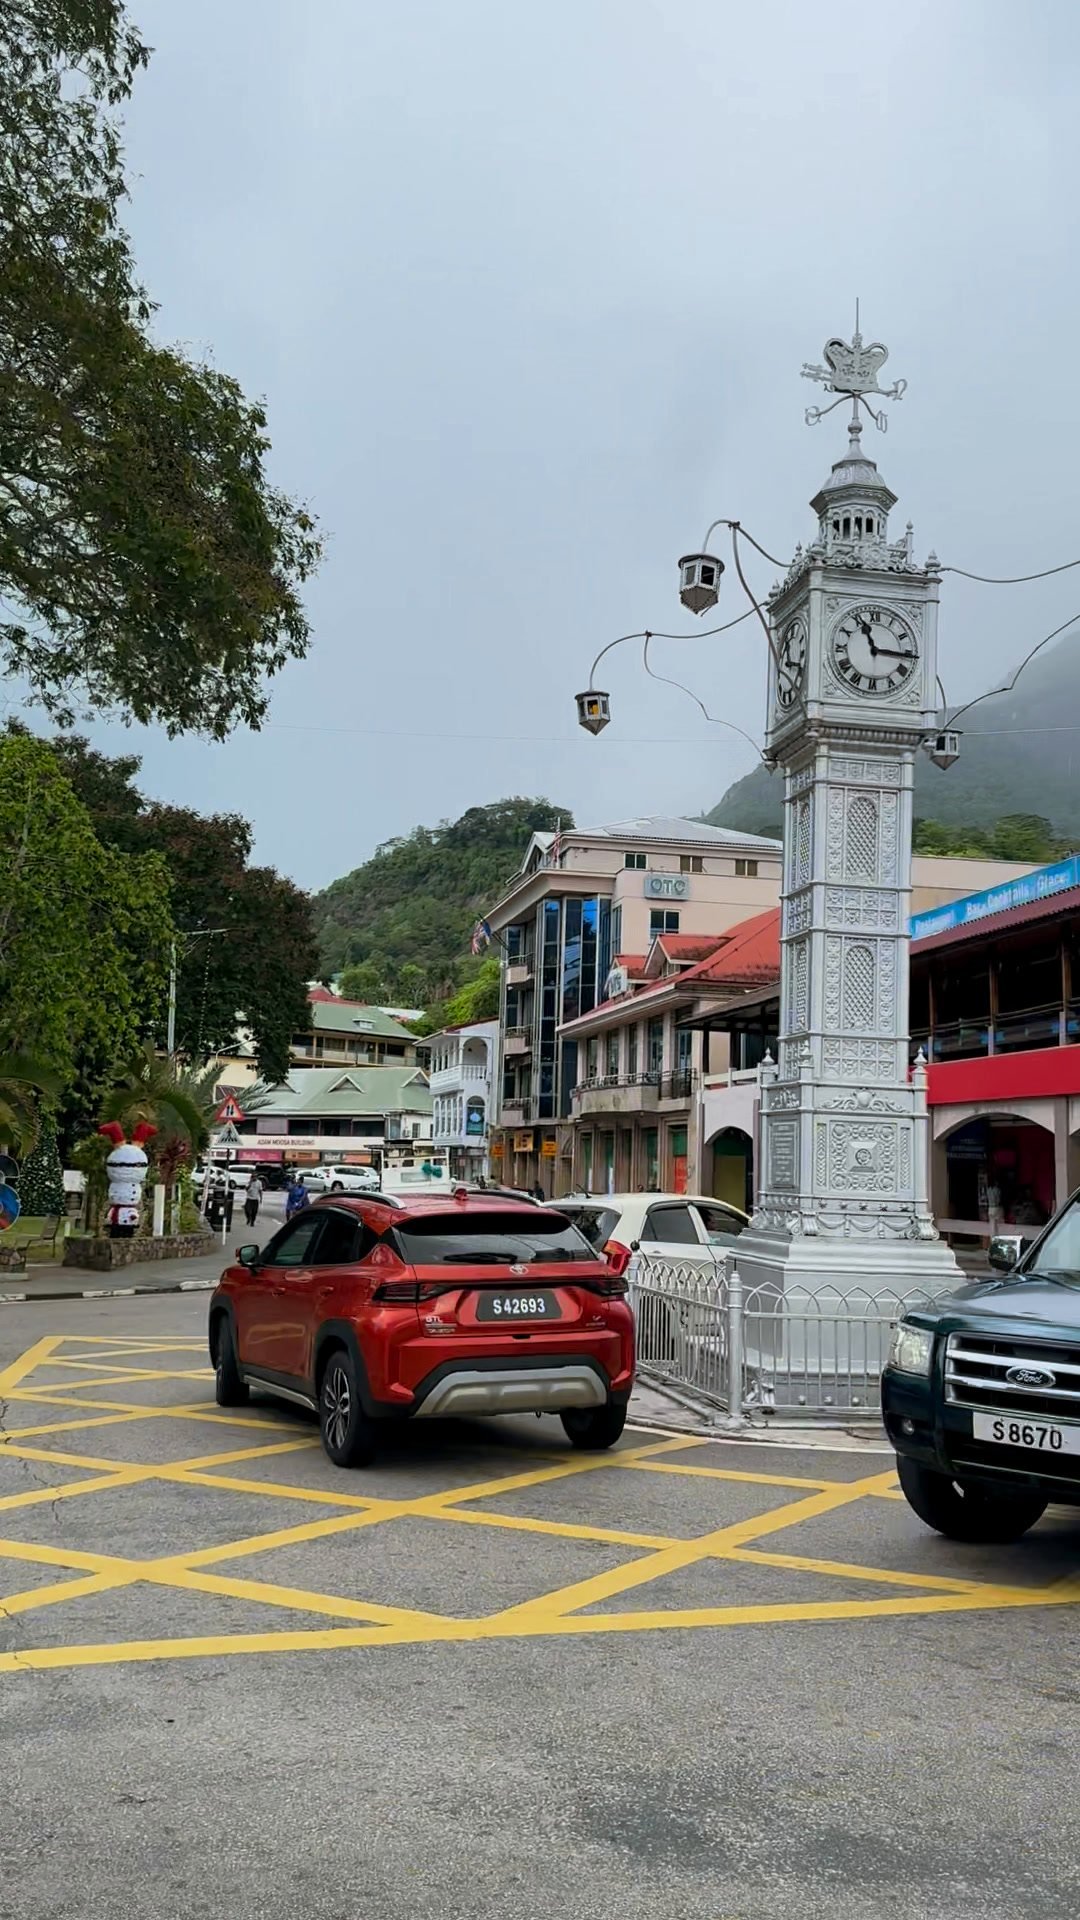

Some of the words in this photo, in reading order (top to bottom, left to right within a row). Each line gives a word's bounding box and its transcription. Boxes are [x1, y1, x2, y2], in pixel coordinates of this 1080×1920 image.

[650, 878, 686, 895] OTC
[257, 1138, 271, 1146] ADAM
[291, 1139, 316, 1147] BUILDING
[492, 1298, 546, 1315] S42693
[1015, 1369, 1043, 1384] Ford
[992, 1421, 1062, 1450] S8670
